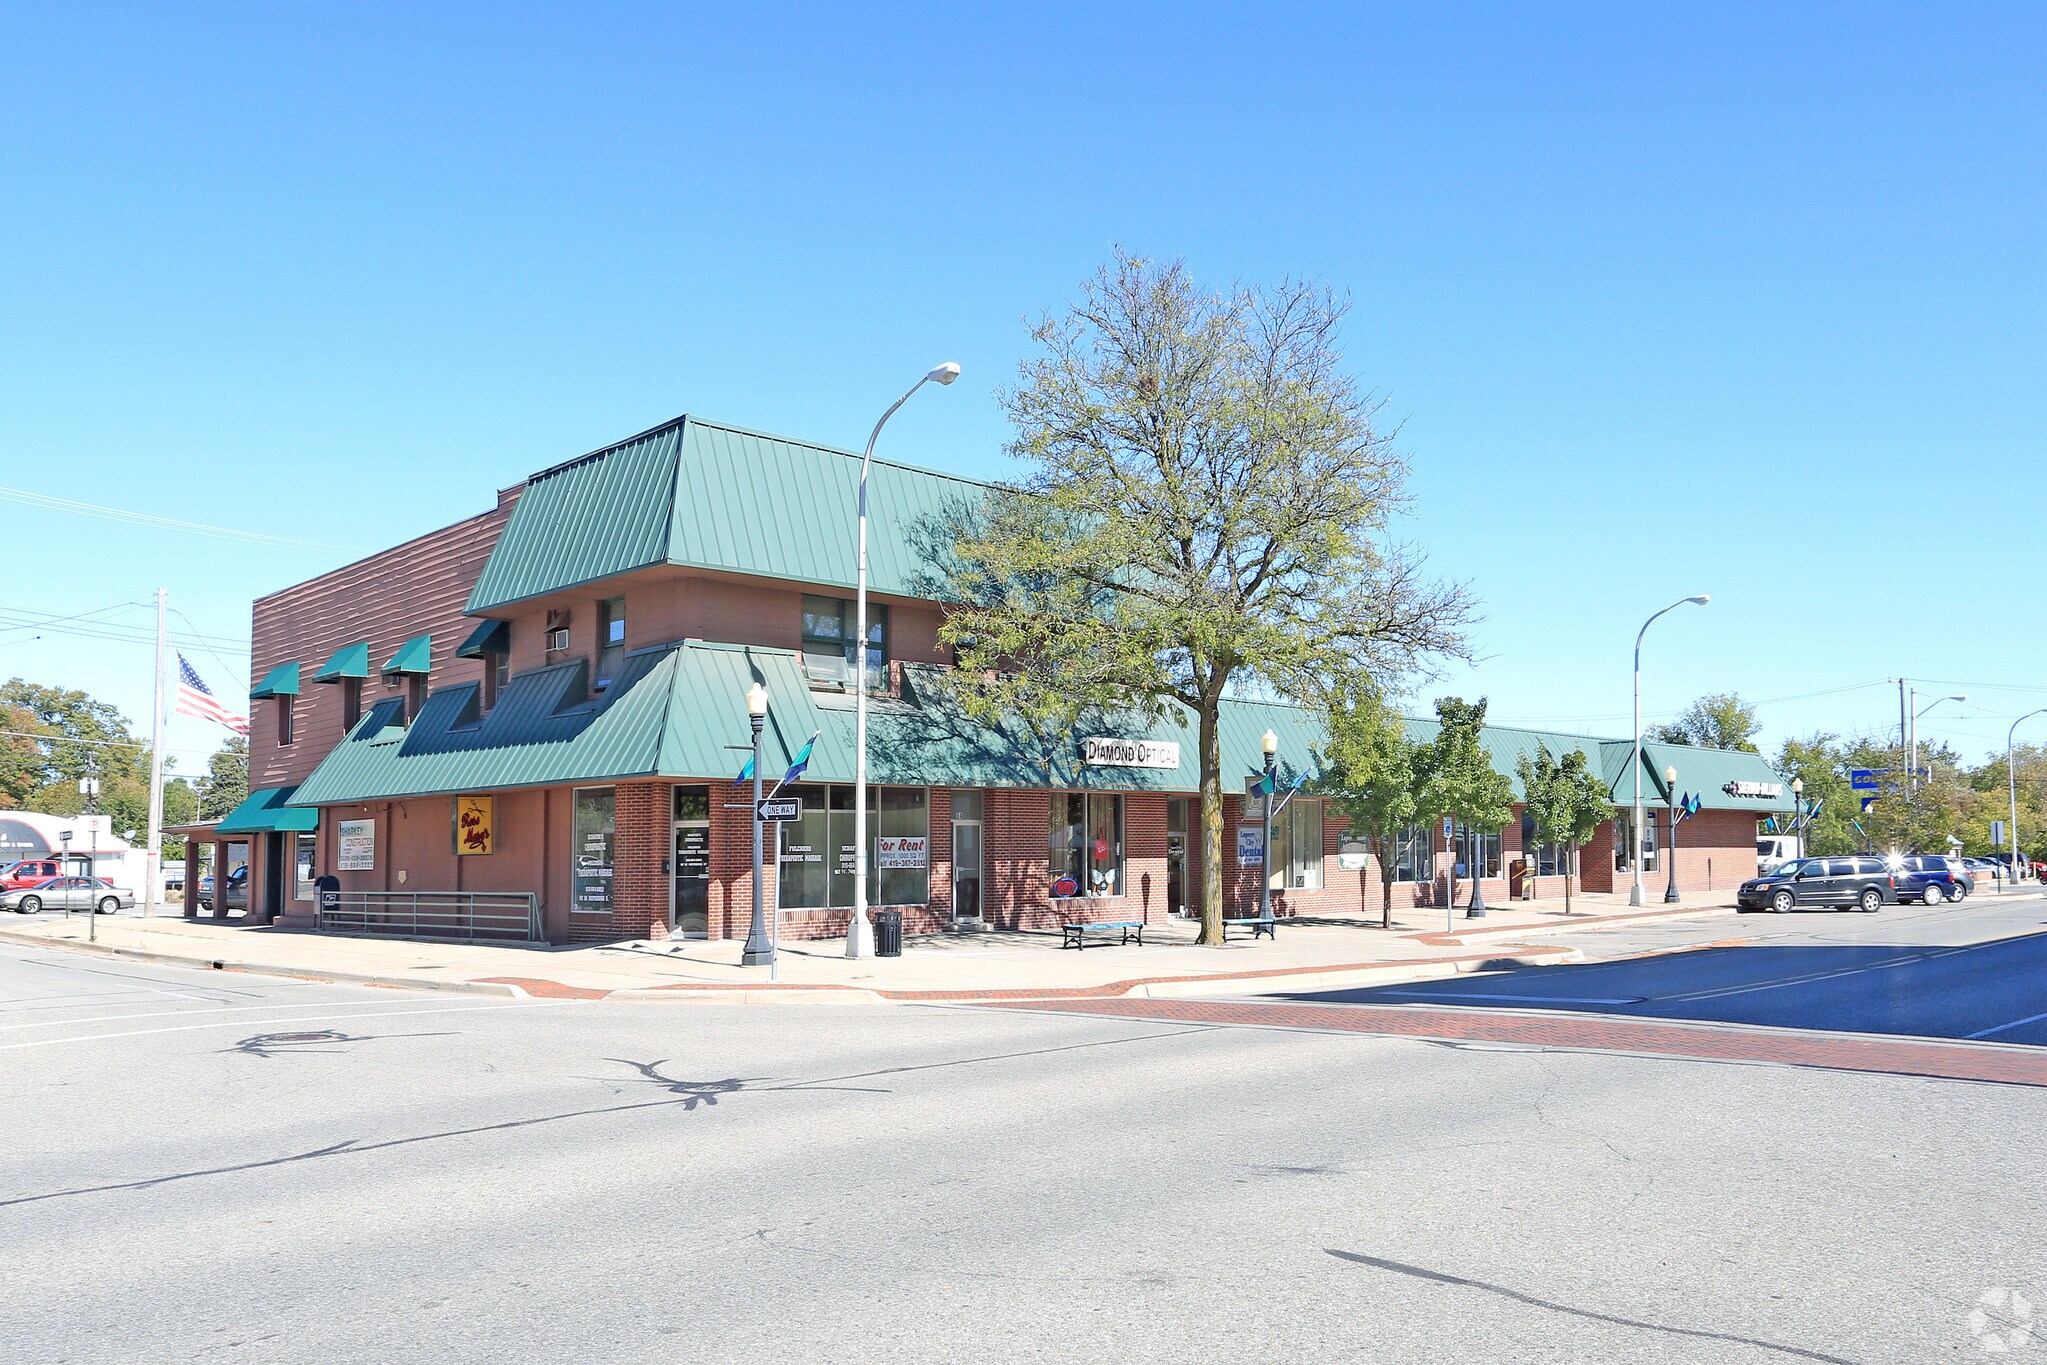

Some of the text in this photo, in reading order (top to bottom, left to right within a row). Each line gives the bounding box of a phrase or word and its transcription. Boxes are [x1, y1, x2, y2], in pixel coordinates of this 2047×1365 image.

[1088, 741, 1176, 764] DIAMOND OPTICAL
[767, 805, 795, 815] ONE WAY
[341, 826, 364, 836] SHARKEY
[898, 838, 925, 851] Rent
[1239, 845, 1264, 857] Dental
